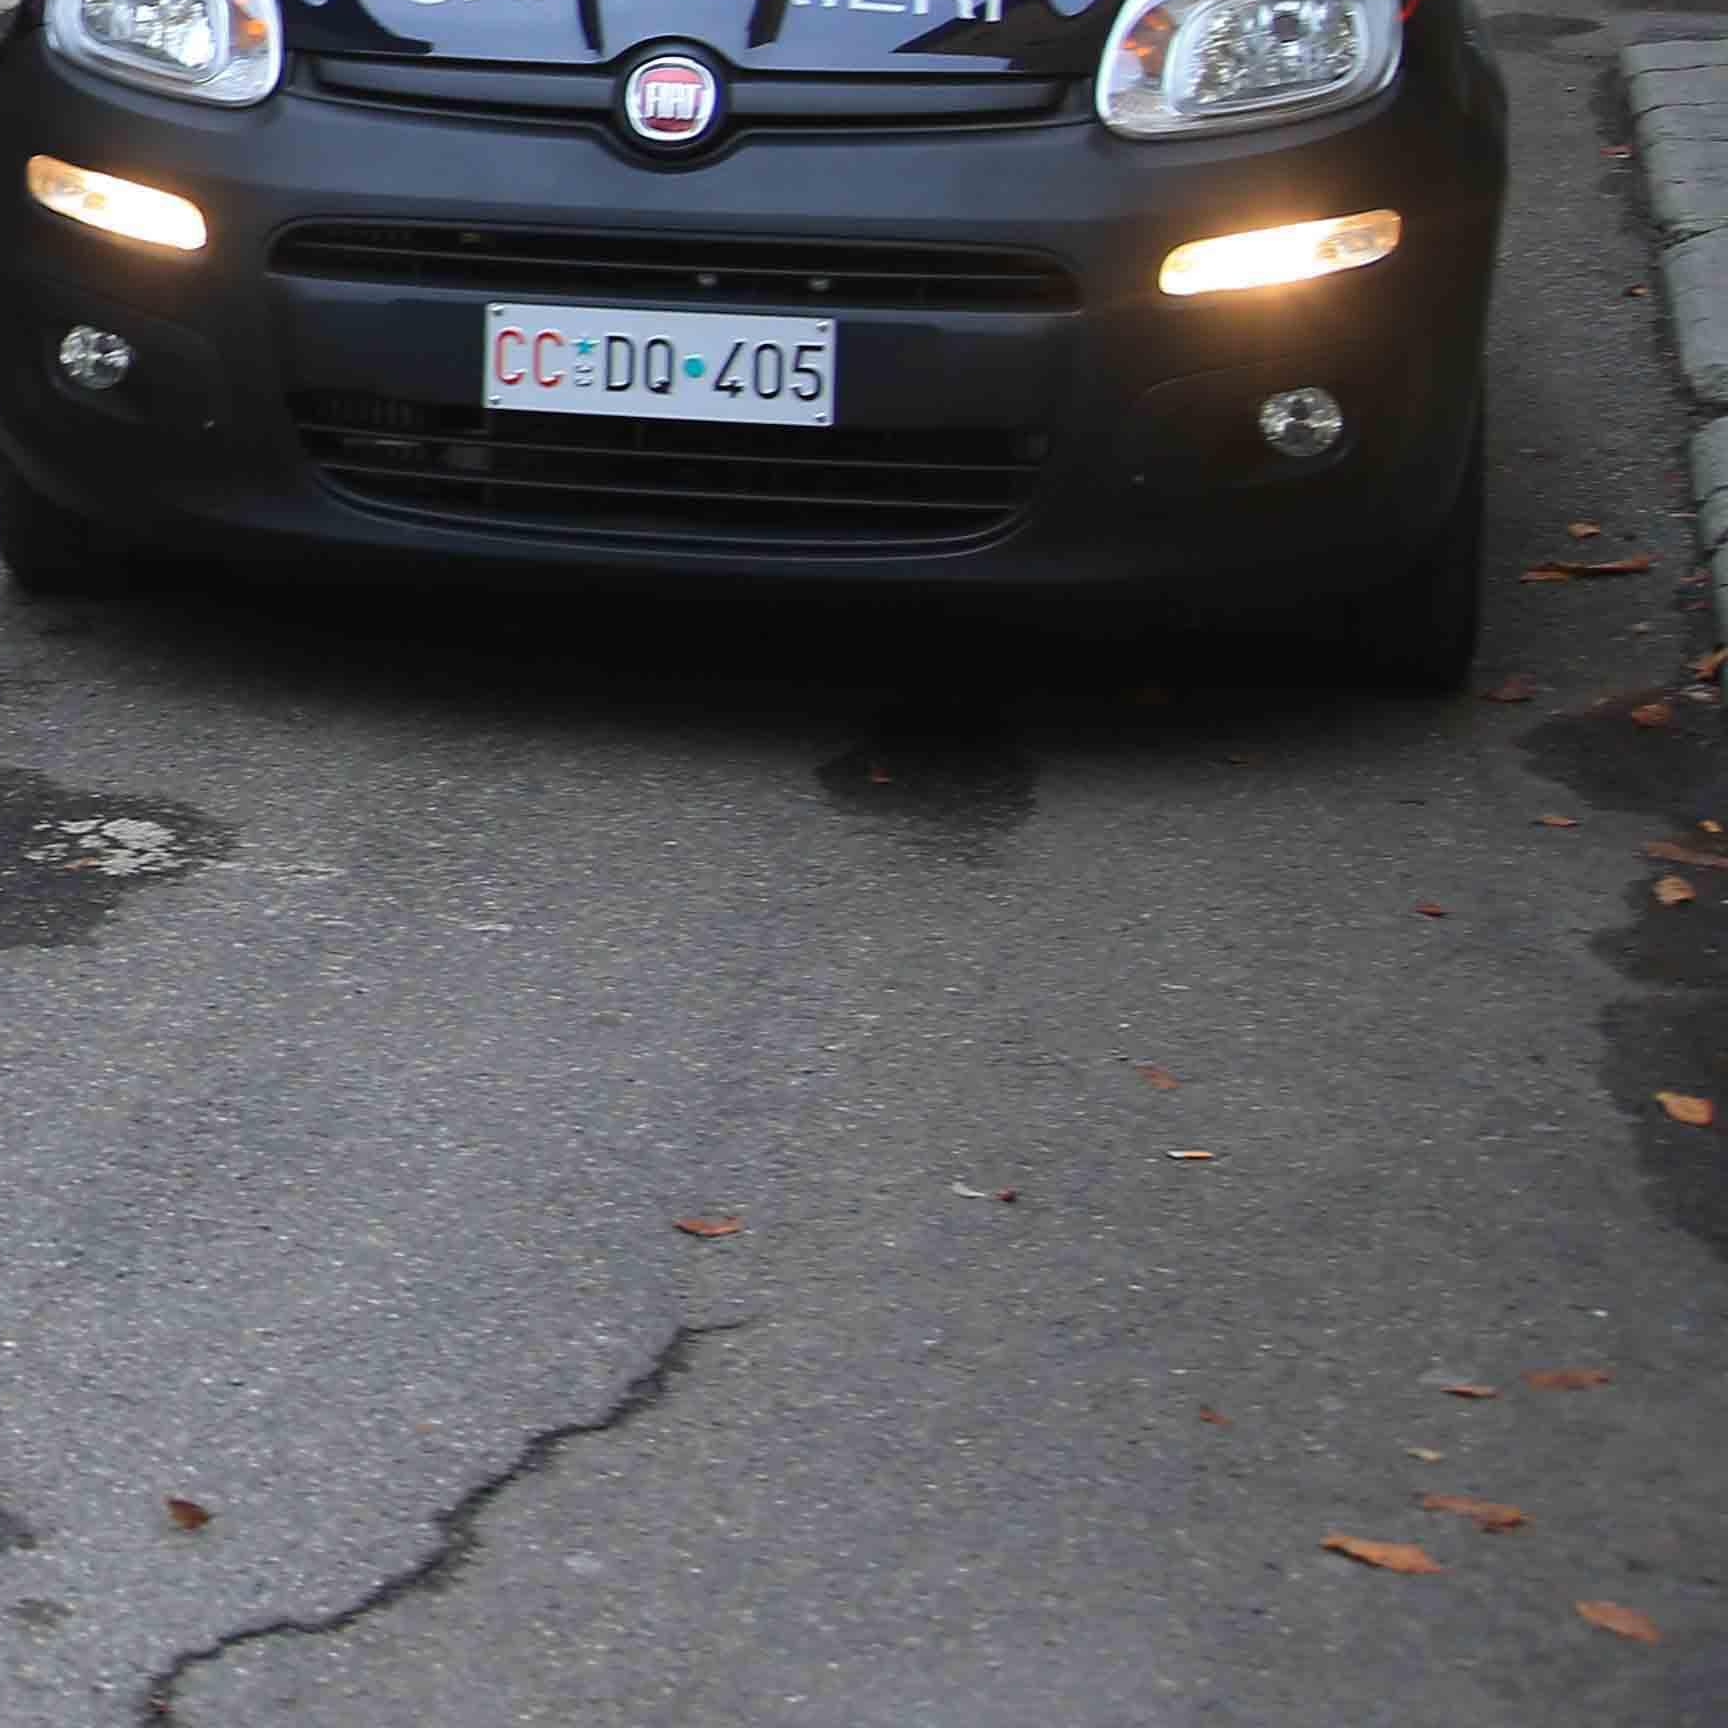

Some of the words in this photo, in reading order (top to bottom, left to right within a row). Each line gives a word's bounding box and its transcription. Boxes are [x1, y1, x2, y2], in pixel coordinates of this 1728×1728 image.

[643, 80, 705, 120] FIAT
[494, 327, 565, 388] CC
[604, 334, 675, 395] DQ
[711, 338, 826, 402] 405
